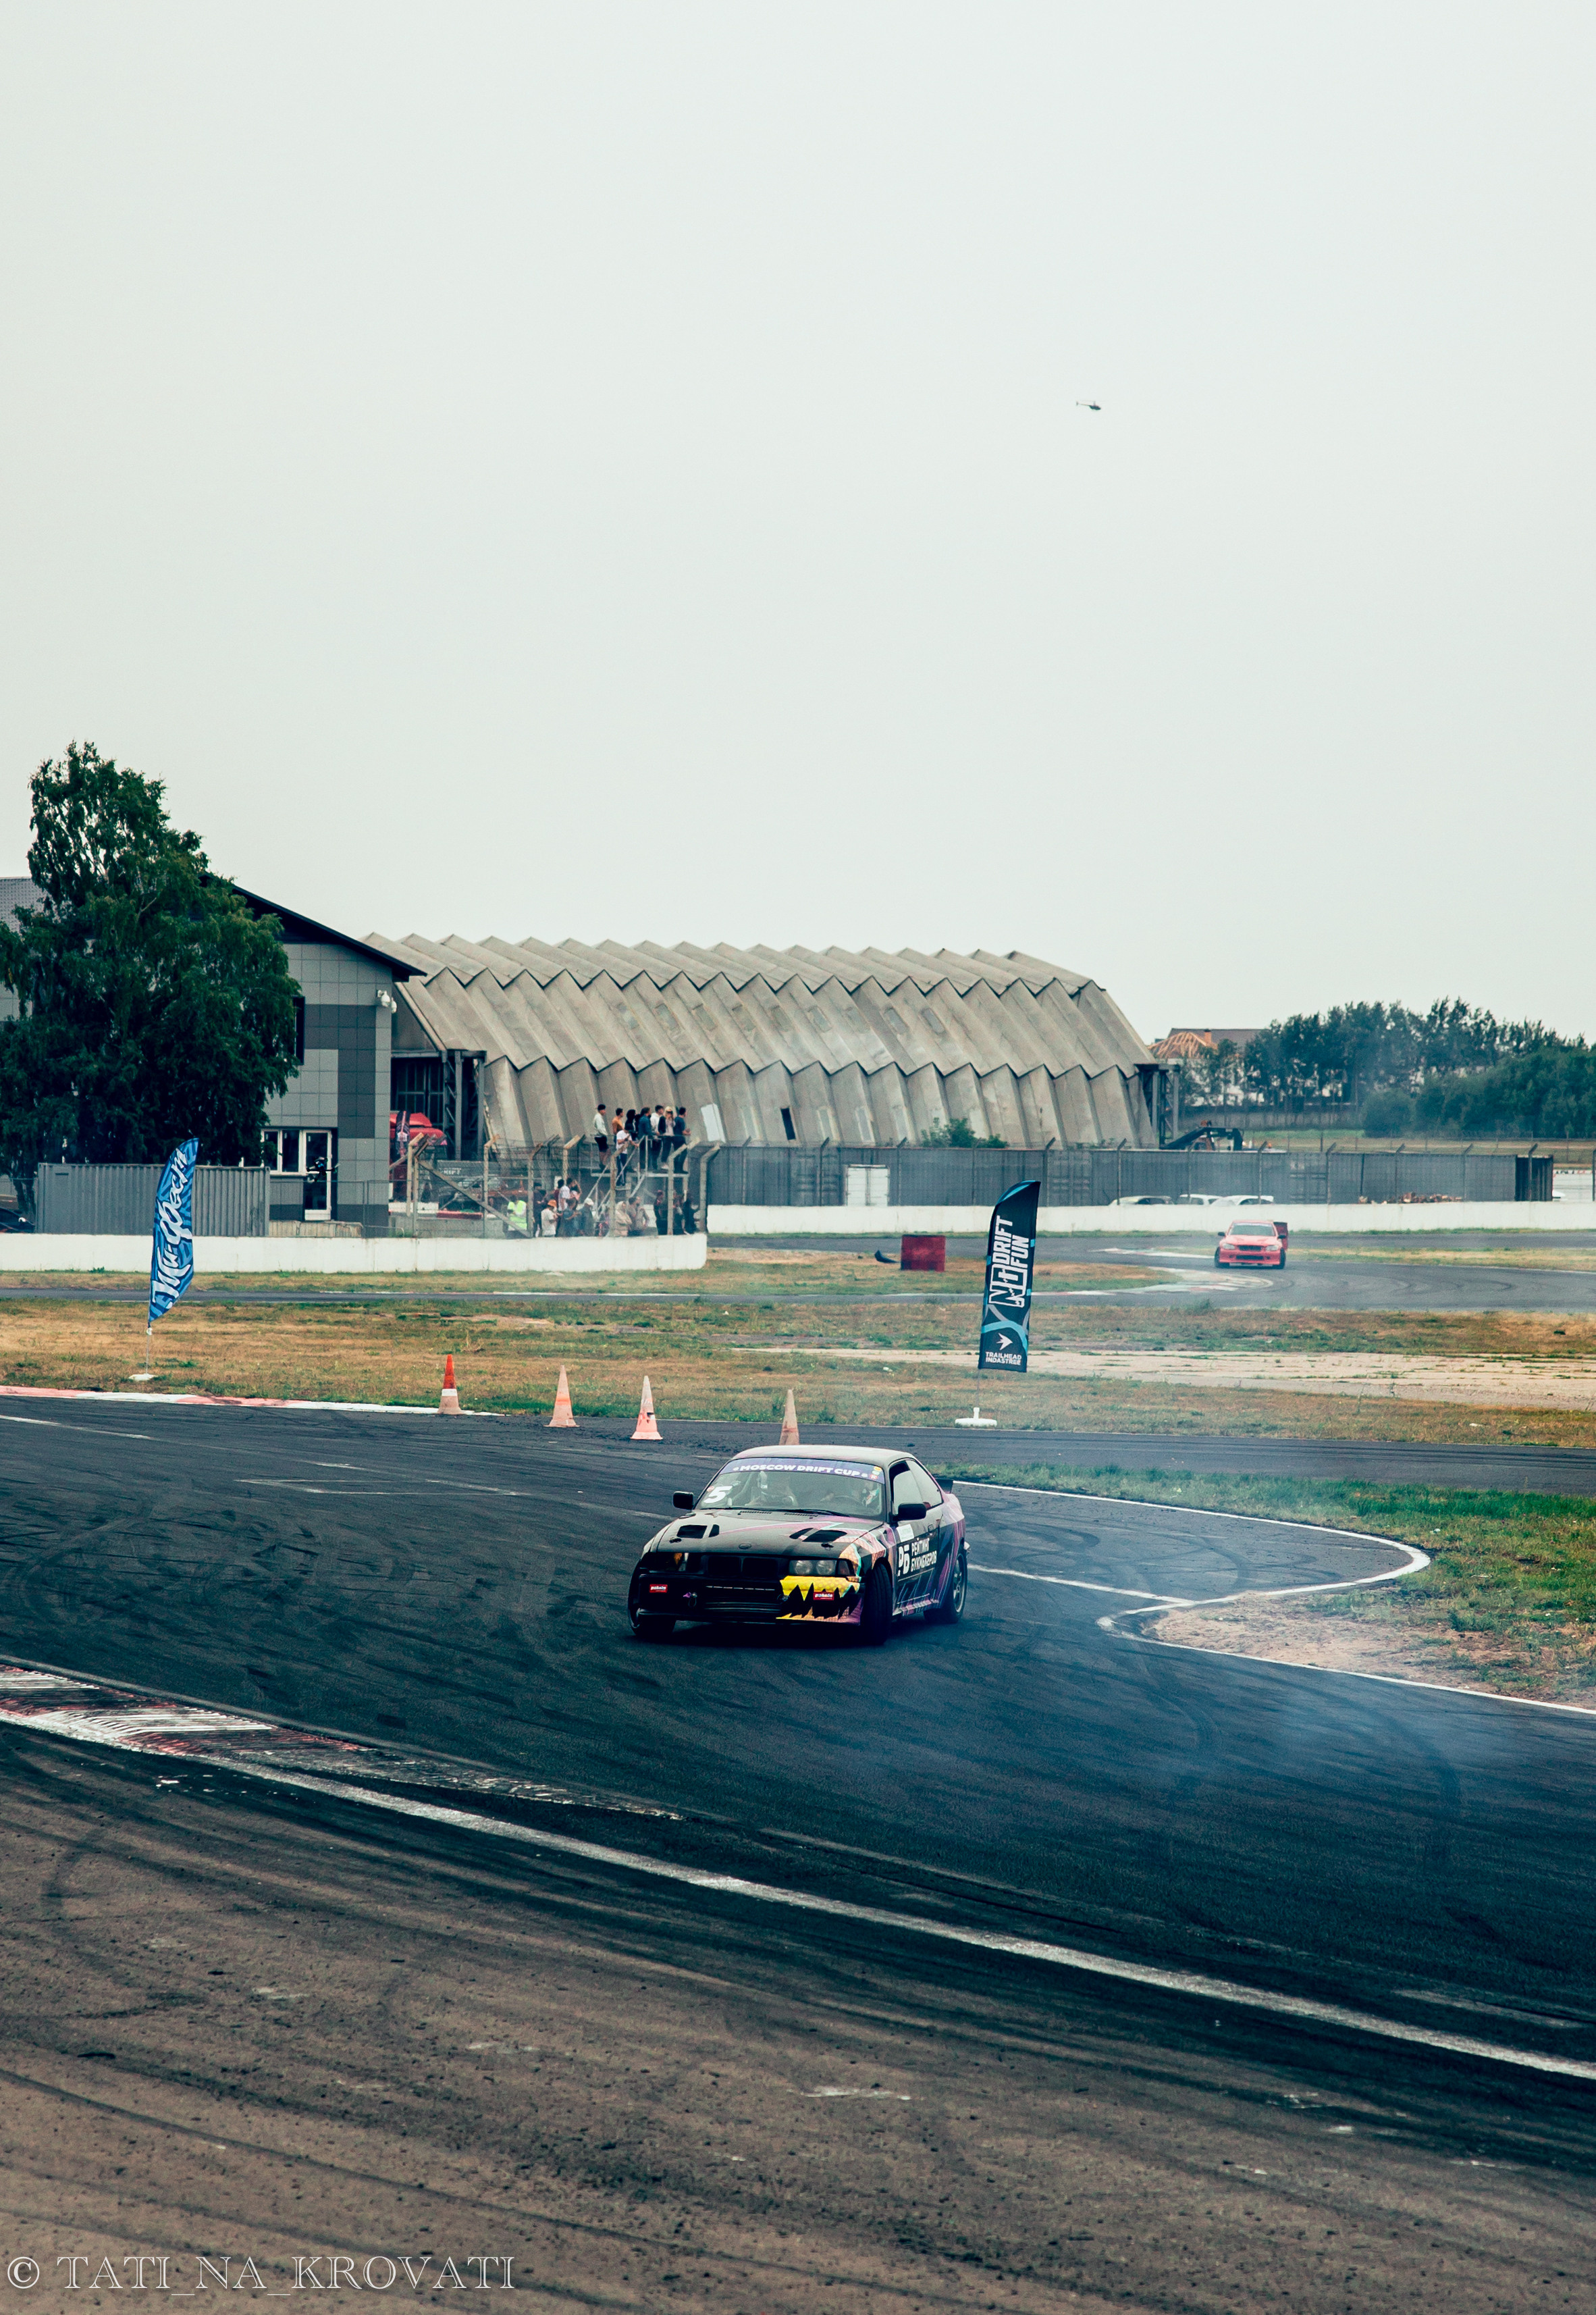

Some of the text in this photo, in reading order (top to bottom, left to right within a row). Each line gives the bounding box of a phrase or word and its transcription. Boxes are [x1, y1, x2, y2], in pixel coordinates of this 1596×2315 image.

[1010, 1234, 1030, 1269] FUN
[988, 1215, 1028, 1308] NO DRIFT
[986, 1351, 1022, 1360] TRAILHEAD
[986, 1357, 1021, 1365] INDASTREE
[797, 1465, 833, 1474] DRIFT
[834, 1467, 861, 1477] CUP
[703, 1485, 733, 1504] 5
